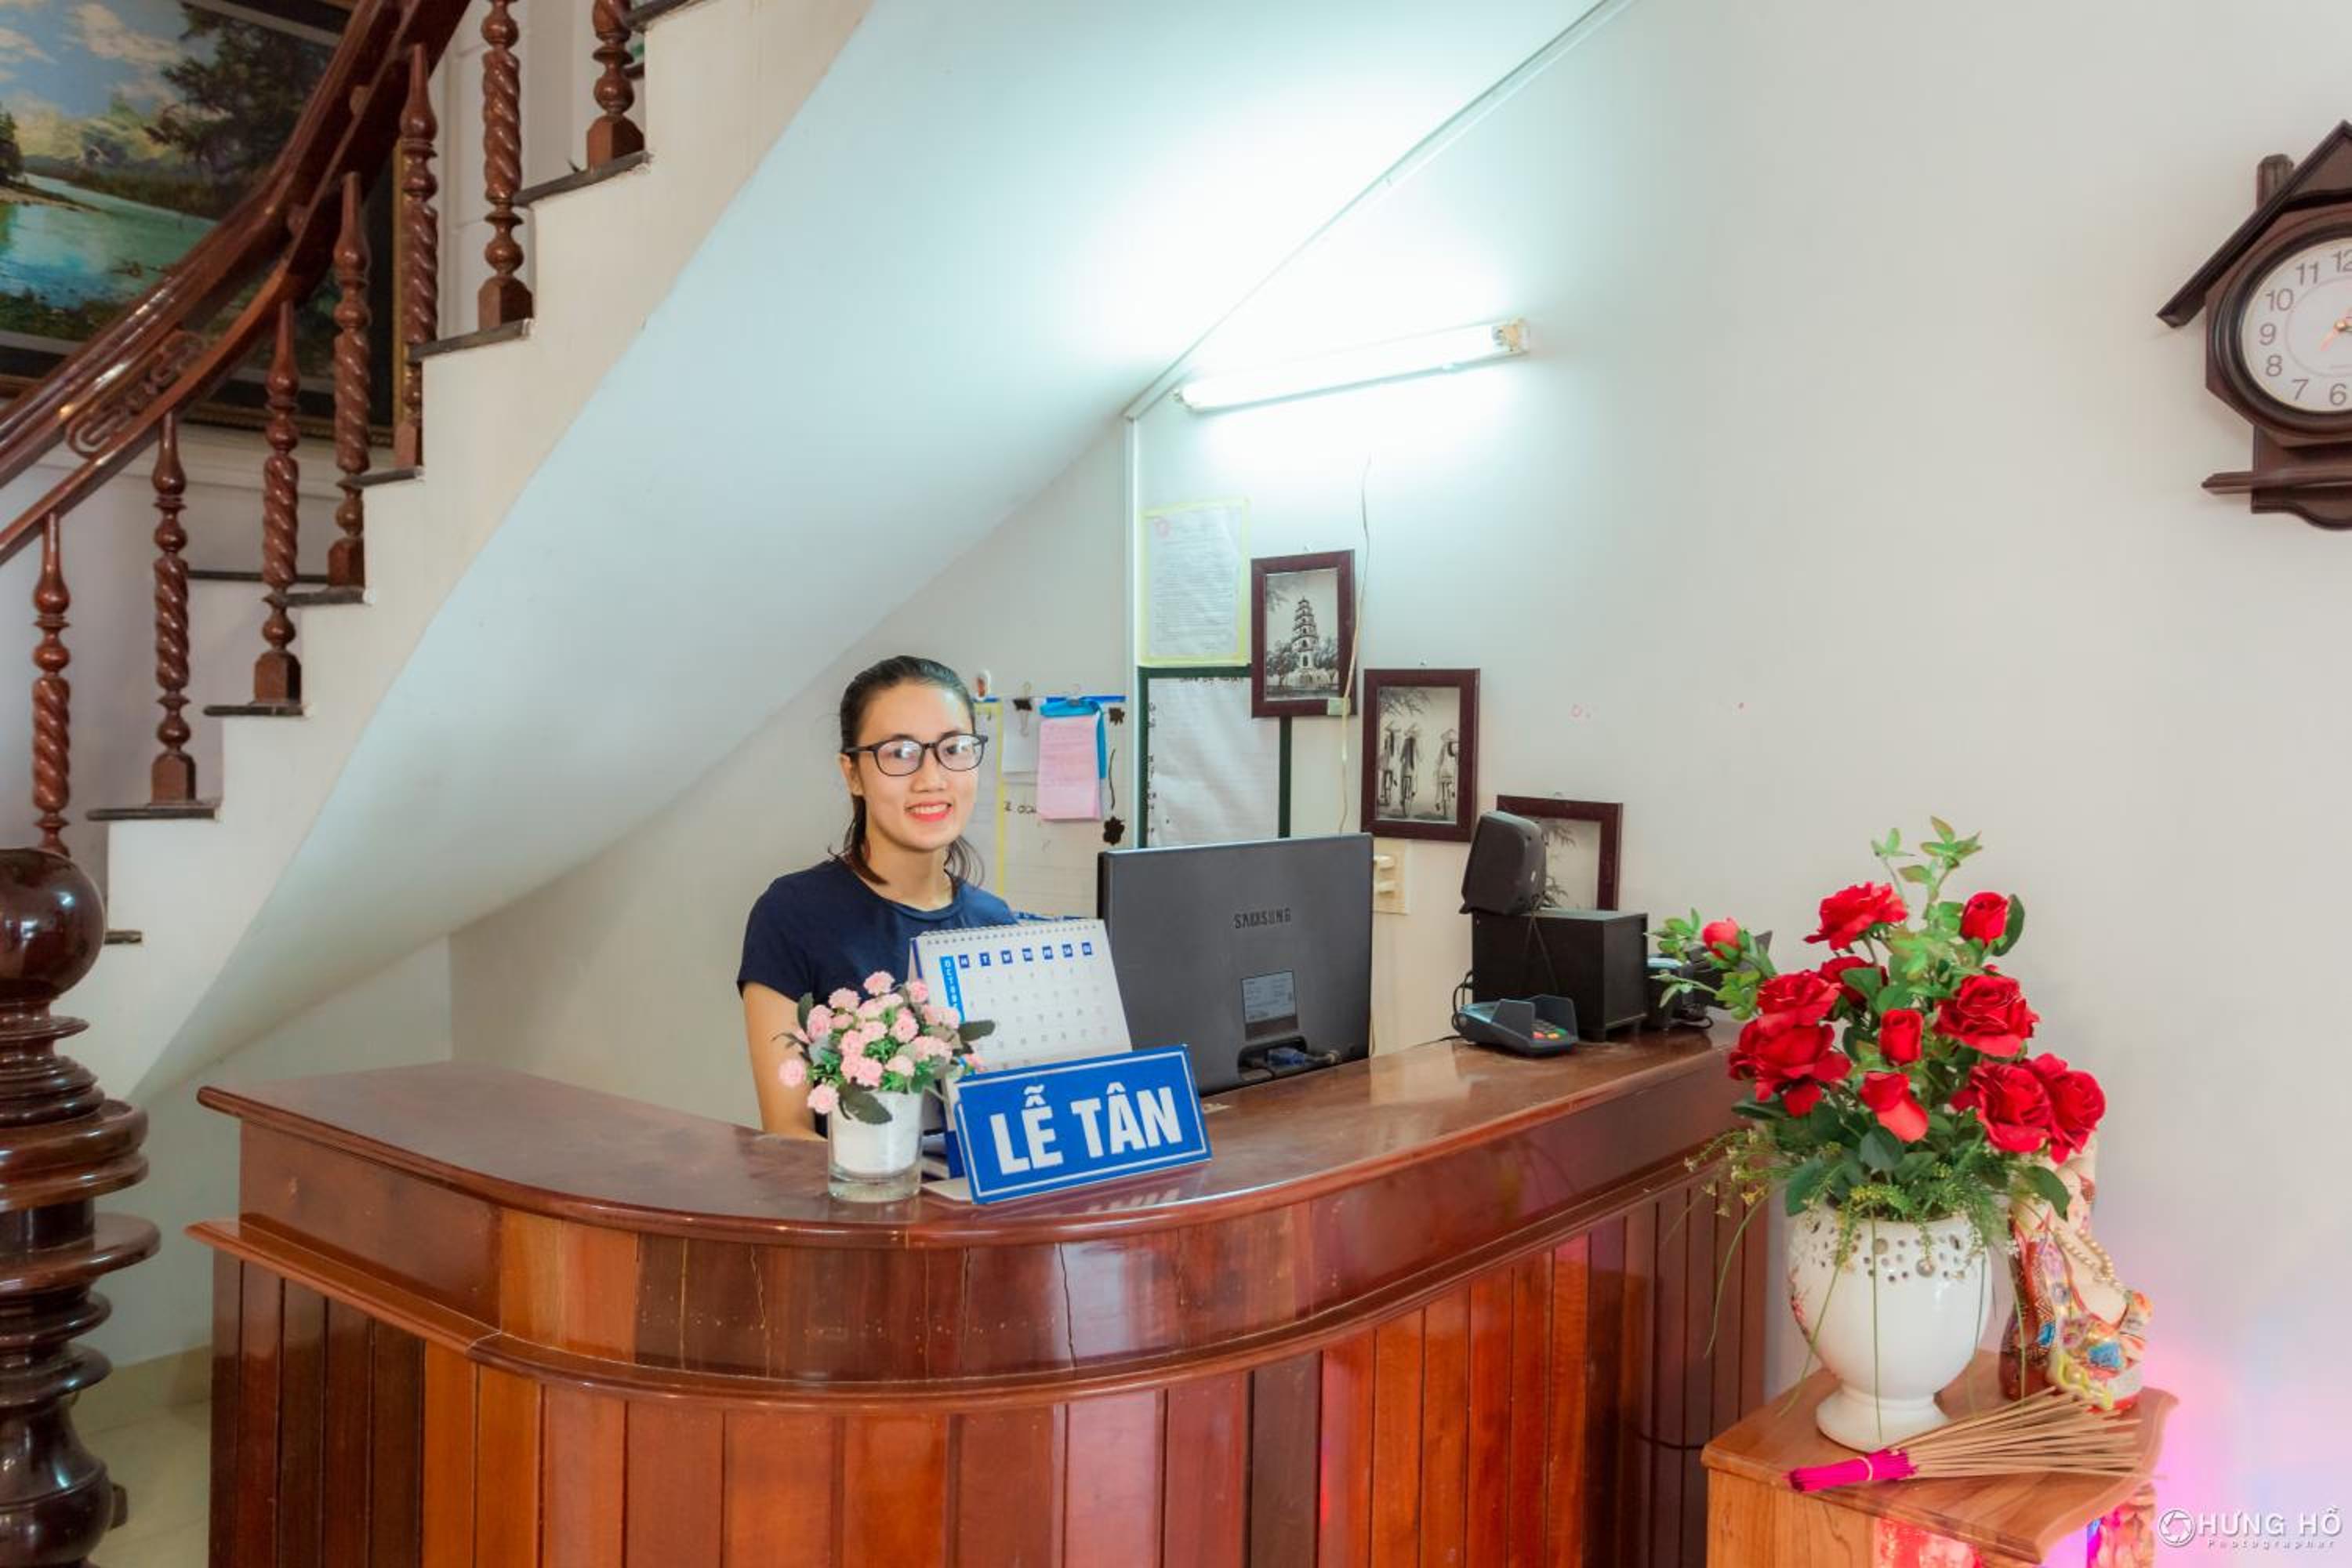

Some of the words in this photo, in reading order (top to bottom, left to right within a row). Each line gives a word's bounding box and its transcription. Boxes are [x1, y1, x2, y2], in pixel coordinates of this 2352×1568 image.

[2296, 262, 2319, 285] 11
[2266, 288, 2294, 311] 10
[2259, 322, 2277, 346] 9
[2265, 354, 2283, 377] 8
[2292, 379, 2309, 400] 7
[2329, 383, 2347, 406] 6
[1234, 907, 1292, 929] SAMSUNG
[989, 1083, 1063, 1176] LỄ
[1070, 1081, 1183, 1159] TÂN
